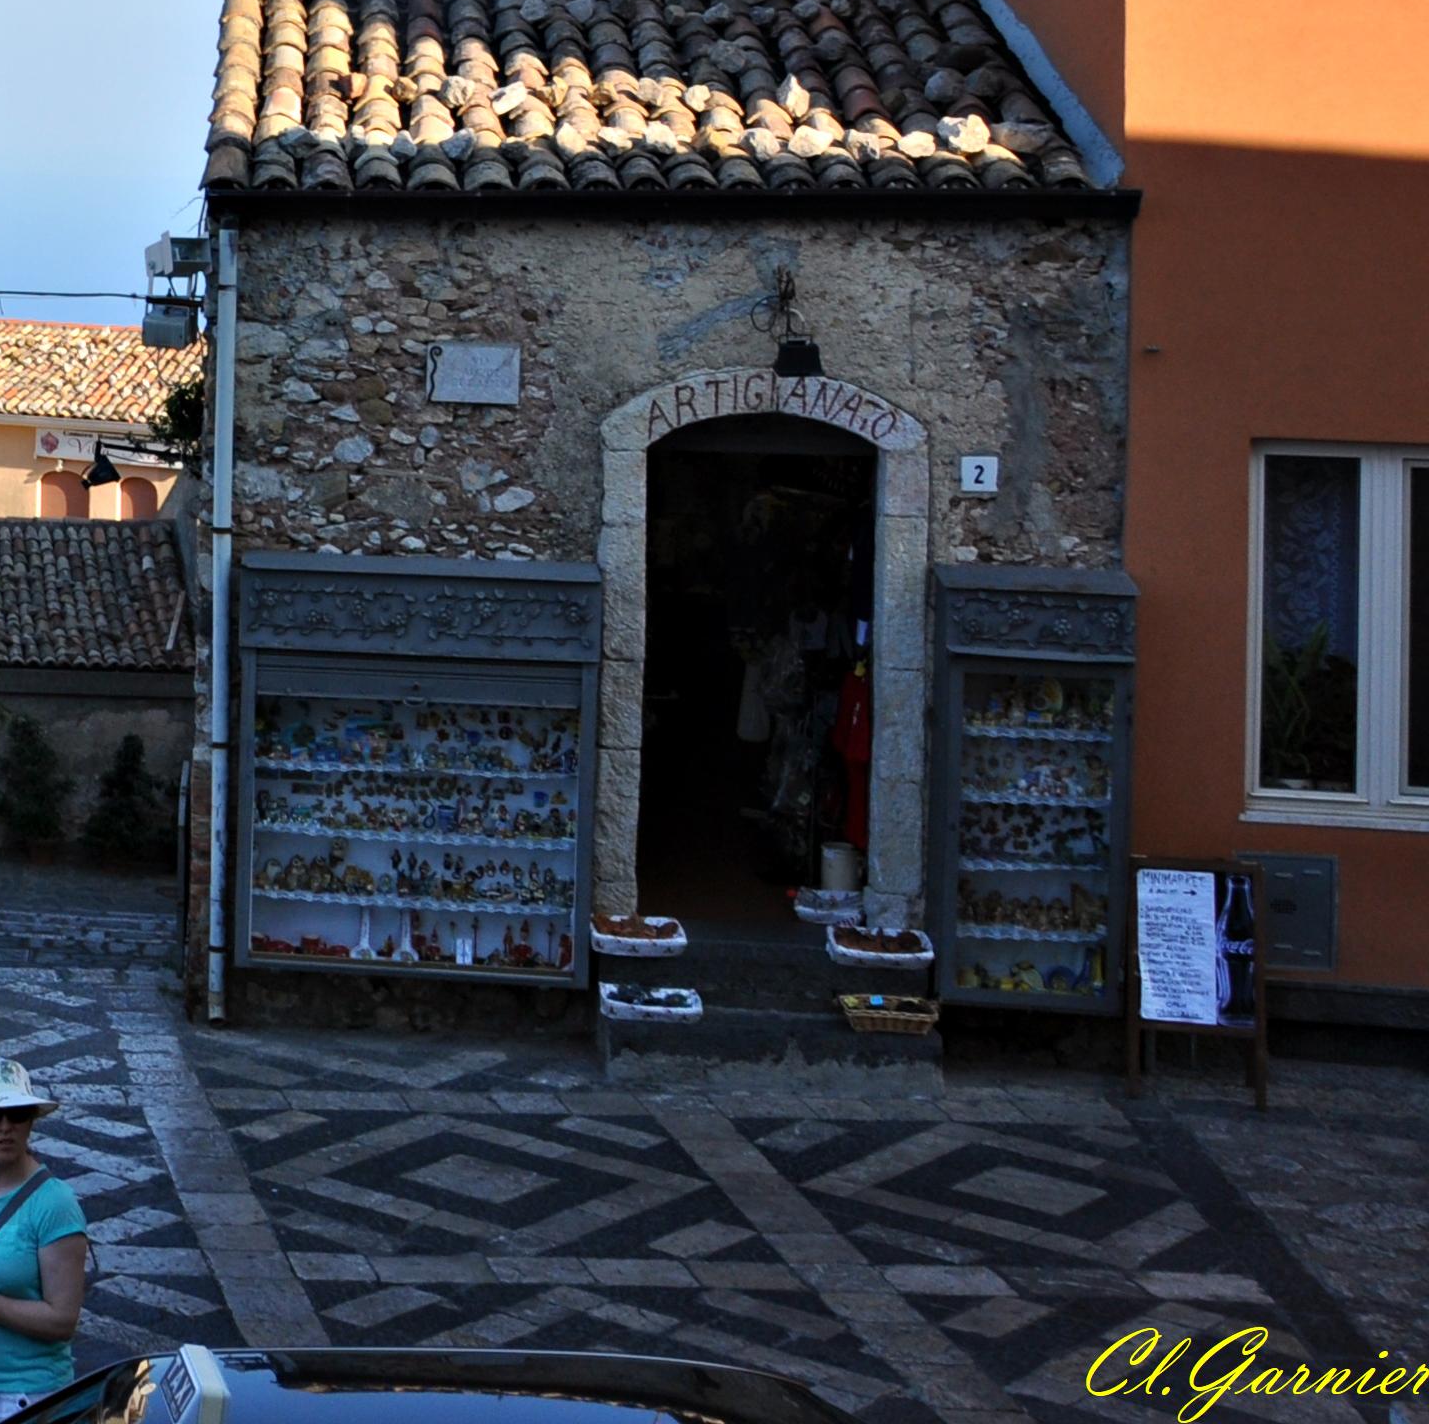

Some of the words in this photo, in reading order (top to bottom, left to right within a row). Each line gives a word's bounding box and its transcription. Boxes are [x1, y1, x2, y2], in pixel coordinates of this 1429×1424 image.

[646, 371, 898, 441] ARTIGIANATO
[973, 464, 985, 485] 2
[166, 1354, 195, 1412] TAXI
